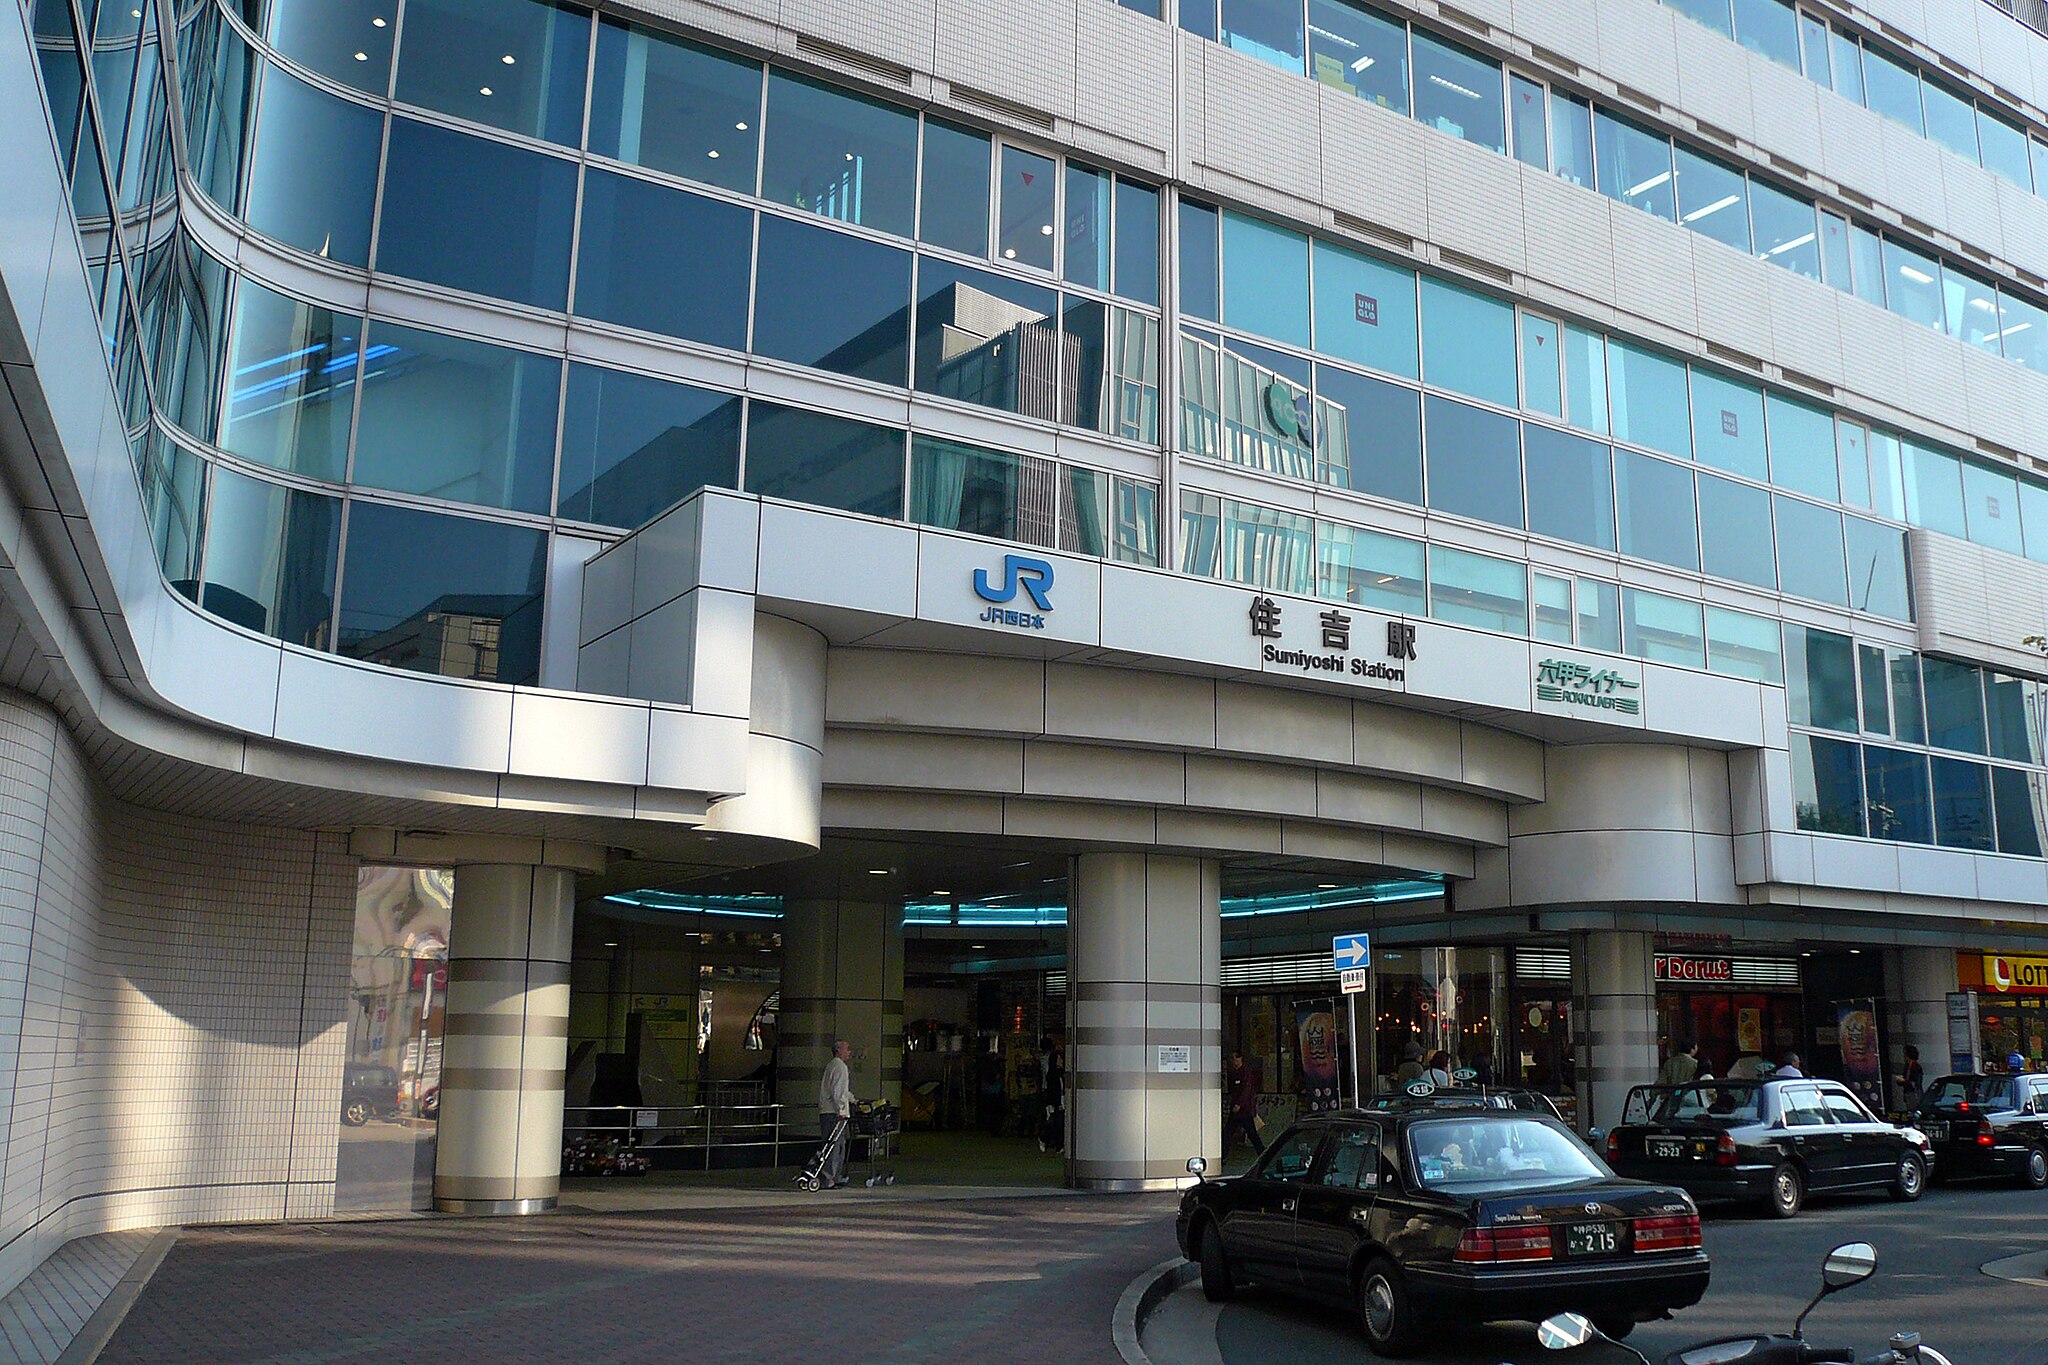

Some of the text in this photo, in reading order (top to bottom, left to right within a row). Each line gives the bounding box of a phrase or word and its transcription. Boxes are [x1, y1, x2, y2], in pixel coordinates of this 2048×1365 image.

[1357, 308, 1376, 320] QLO
[1358, 299, 1375, 311] UNI
[973, 554, 1055, 611] JR
[979, 606, 1045, 629] JR西日本
[1249, 596, 1417, 661] 住吉駅
[1263, 644, 1405, 682] Sumiyoshi Station
[1536, 658, 1640, 693] 六甲ライナー
[1668, 957, 1731, 980] Donut
